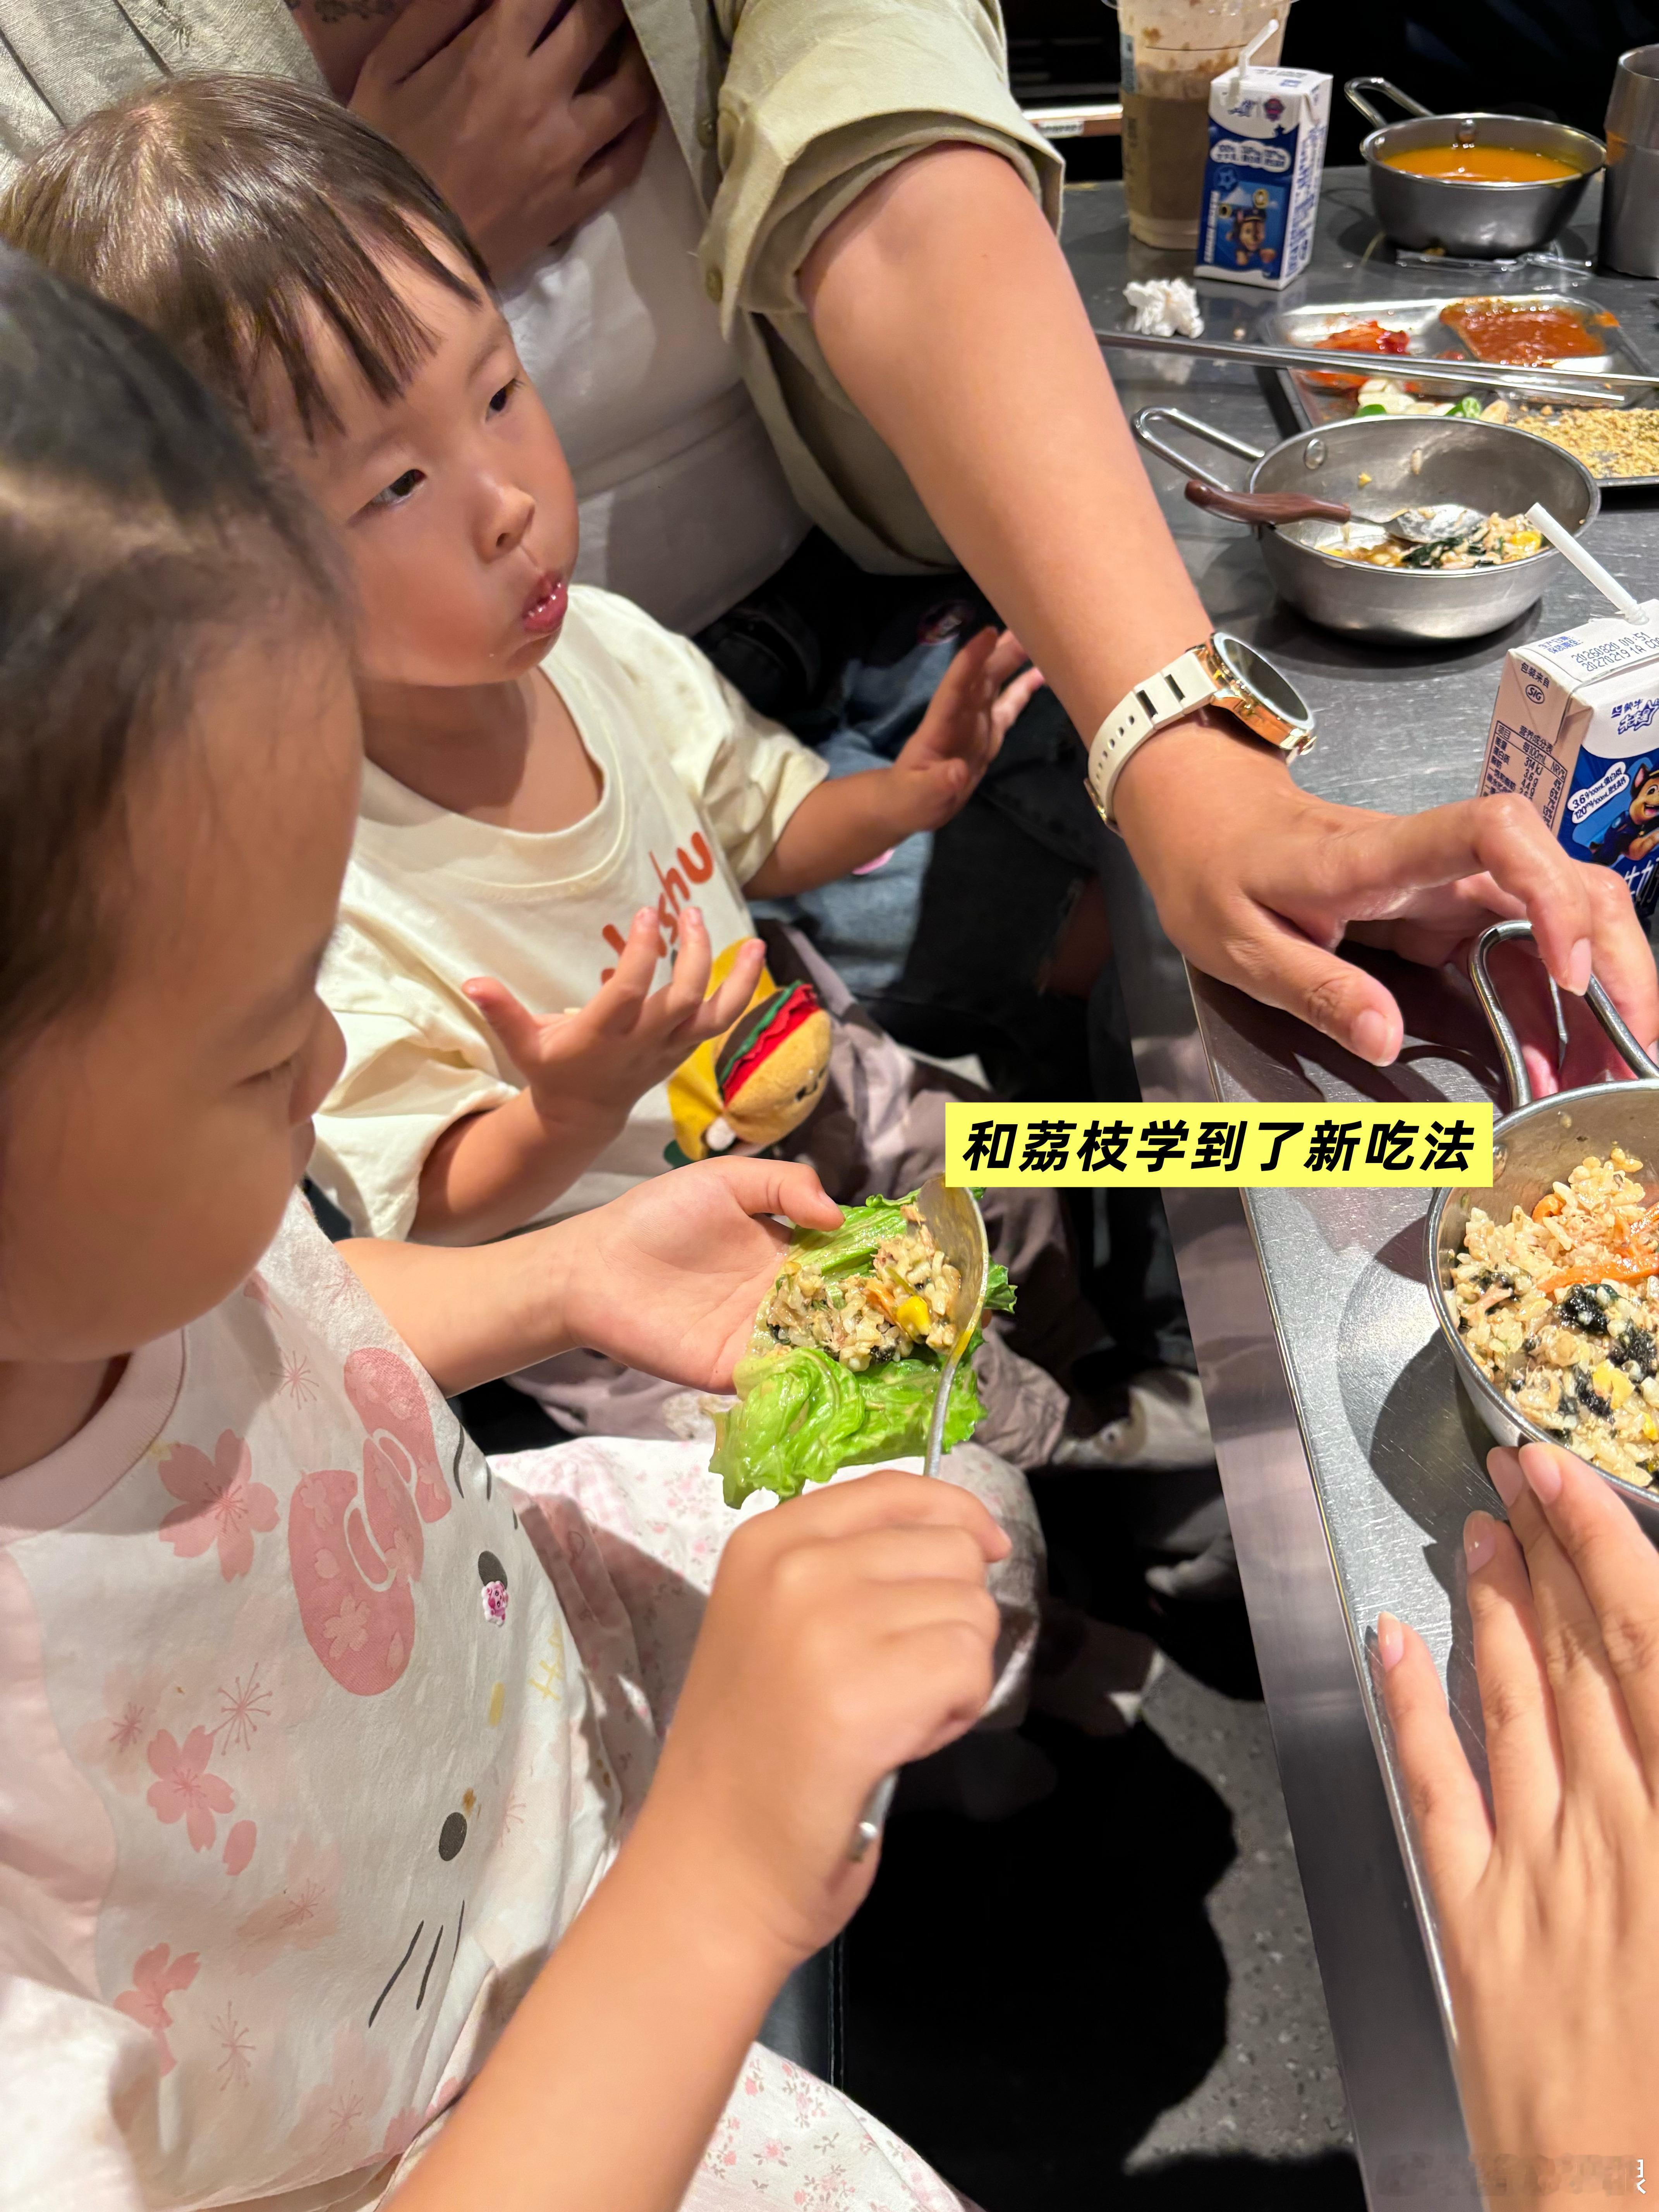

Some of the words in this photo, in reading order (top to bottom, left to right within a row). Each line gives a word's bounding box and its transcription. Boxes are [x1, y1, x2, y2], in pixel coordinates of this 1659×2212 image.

[1571, 642, 1620, 663] 20260820
[1618, 632, 1651, 646] 00:51
[1582, 649, 1631, 672] 20270219
[1521, 662, 1550, 689] 包装来自
[1528, 687, 1542, 701] SIG
[1519, 725, 1554, 754] 营养成分表
